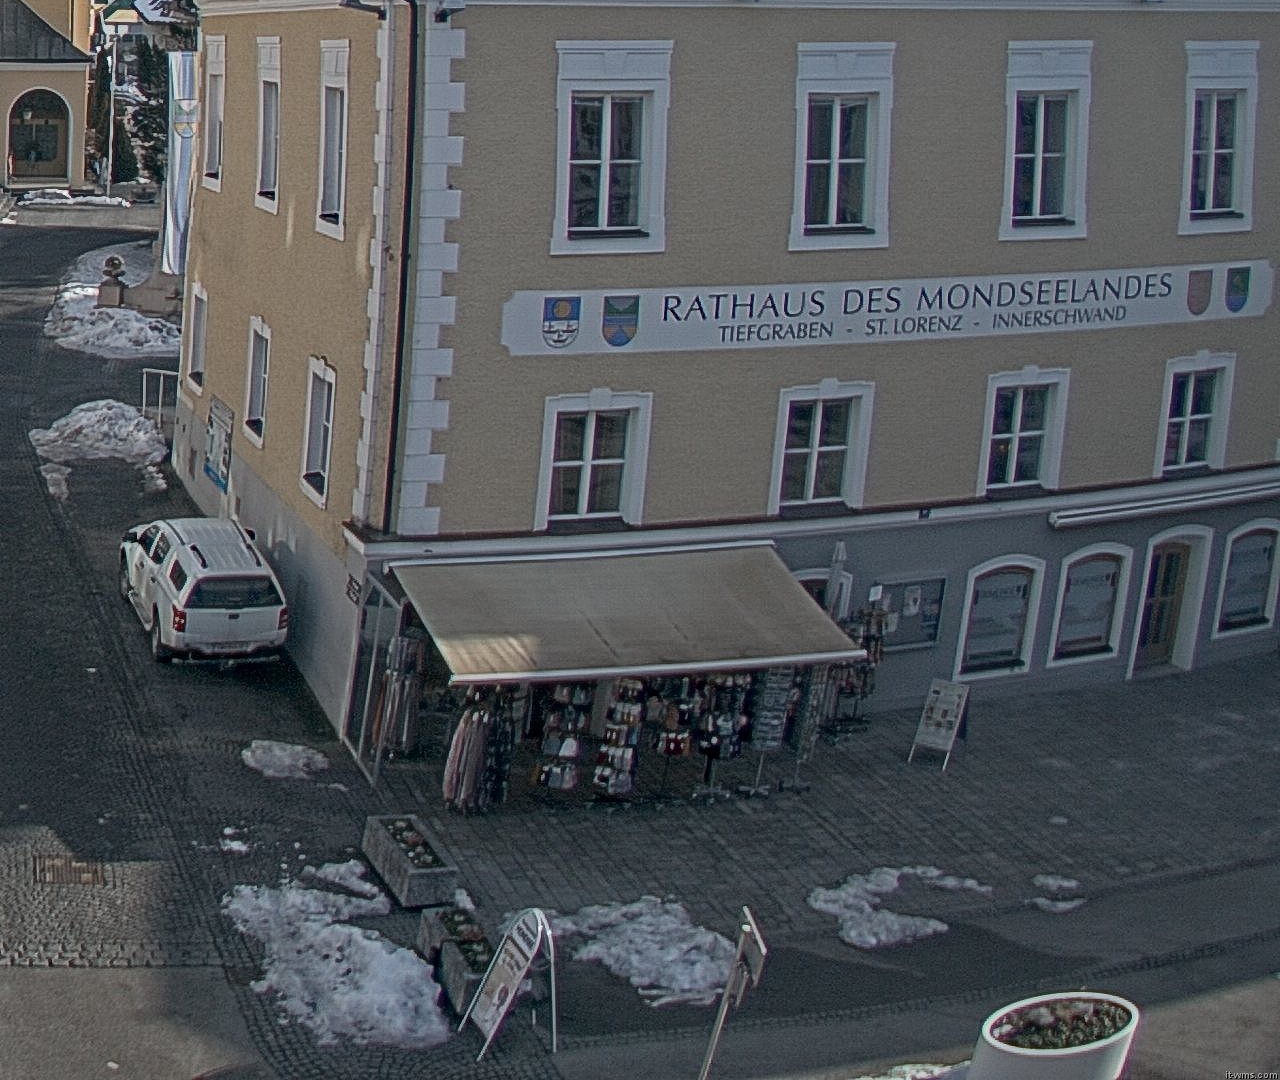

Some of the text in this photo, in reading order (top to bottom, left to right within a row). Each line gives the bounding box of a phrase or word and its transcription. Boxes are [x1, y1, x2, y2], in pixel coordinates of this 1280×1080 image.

[662, 273, 1172, 321] RATHAUS DES MONDSEELANDES
[718, 321, 834, 343] TIEFGRABEN
[864, 319, 888, 336] ST.
[893, 315, 962, 334] LORENZ
[992, 306, 1126, 328] INNERSCHWAND
